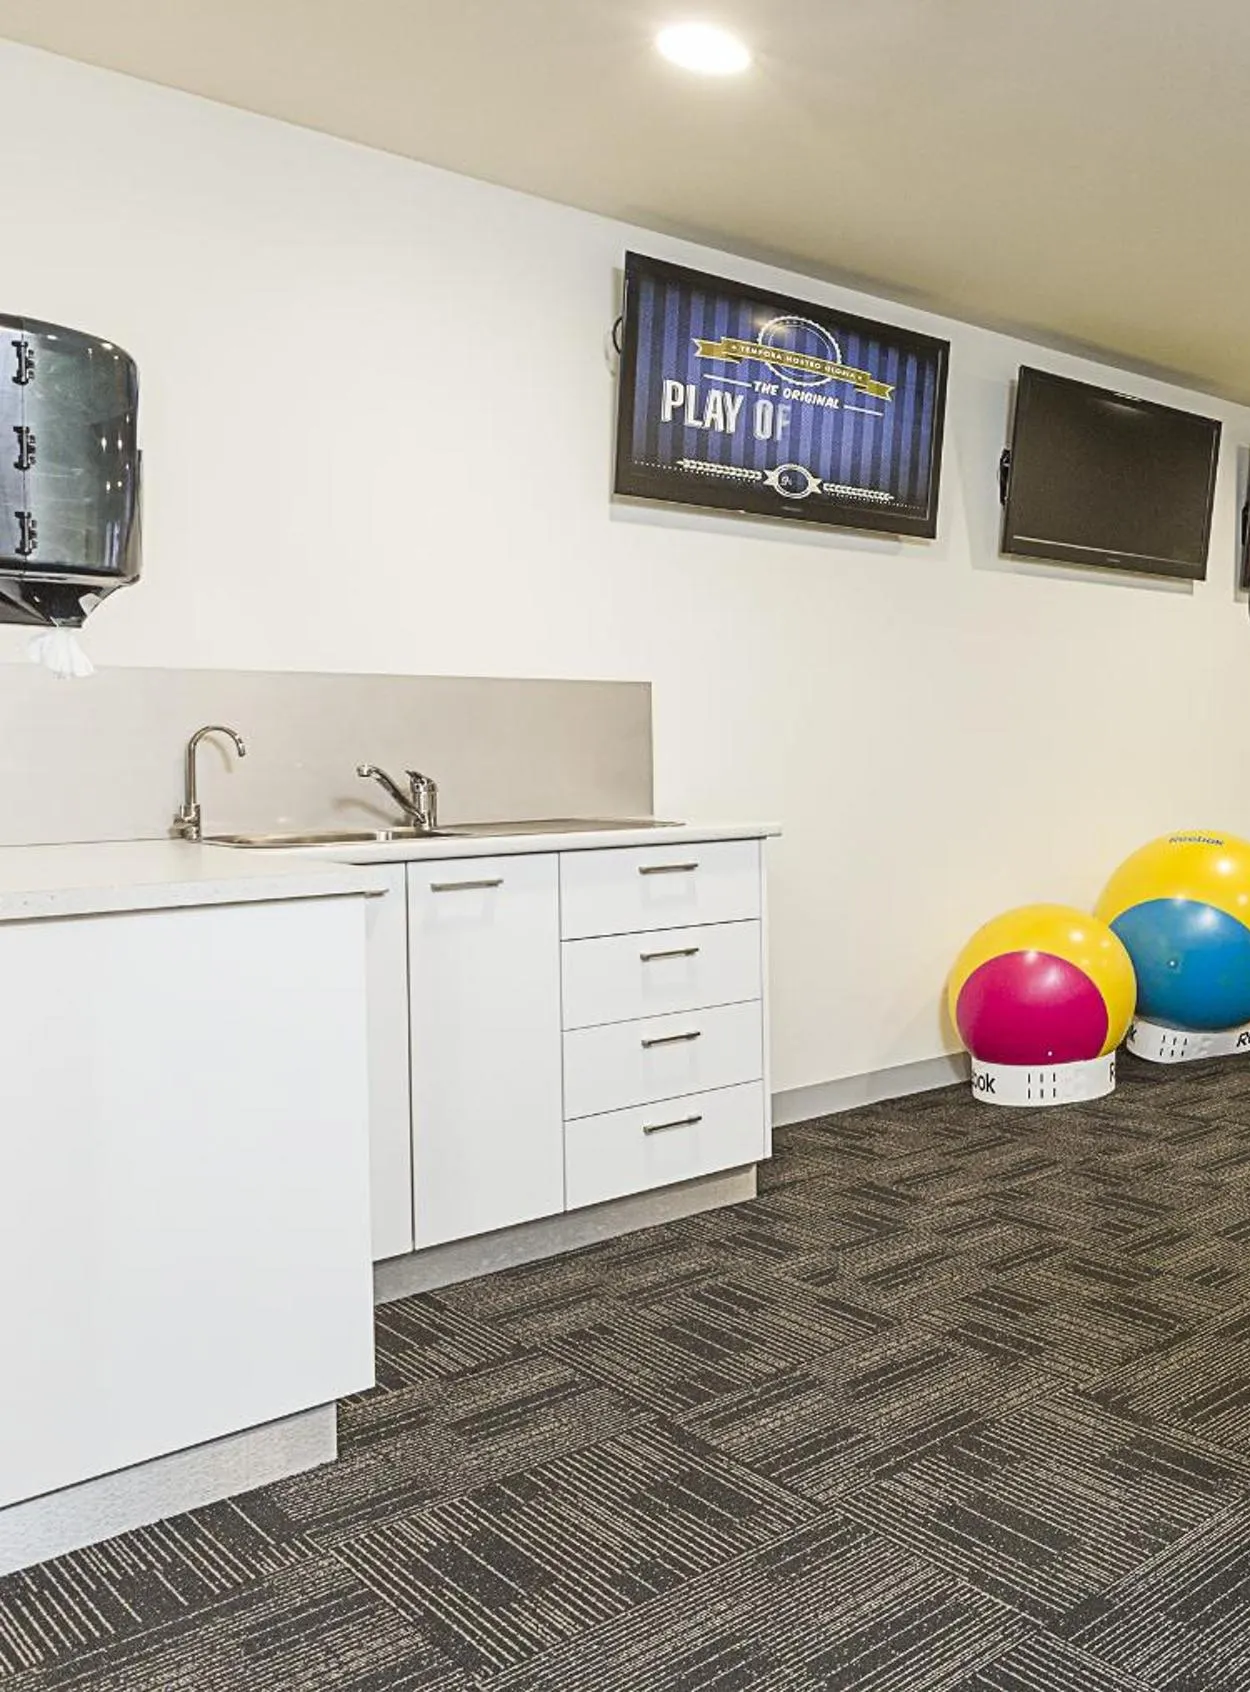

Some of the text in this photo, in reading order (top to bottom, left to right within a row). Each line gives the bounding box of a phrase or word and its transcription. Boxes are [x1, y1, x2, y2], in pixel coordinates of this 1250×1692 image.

[661, 379, 744, 434] PLAY
[752, 380, 840, 409] THE ORIGINAL
